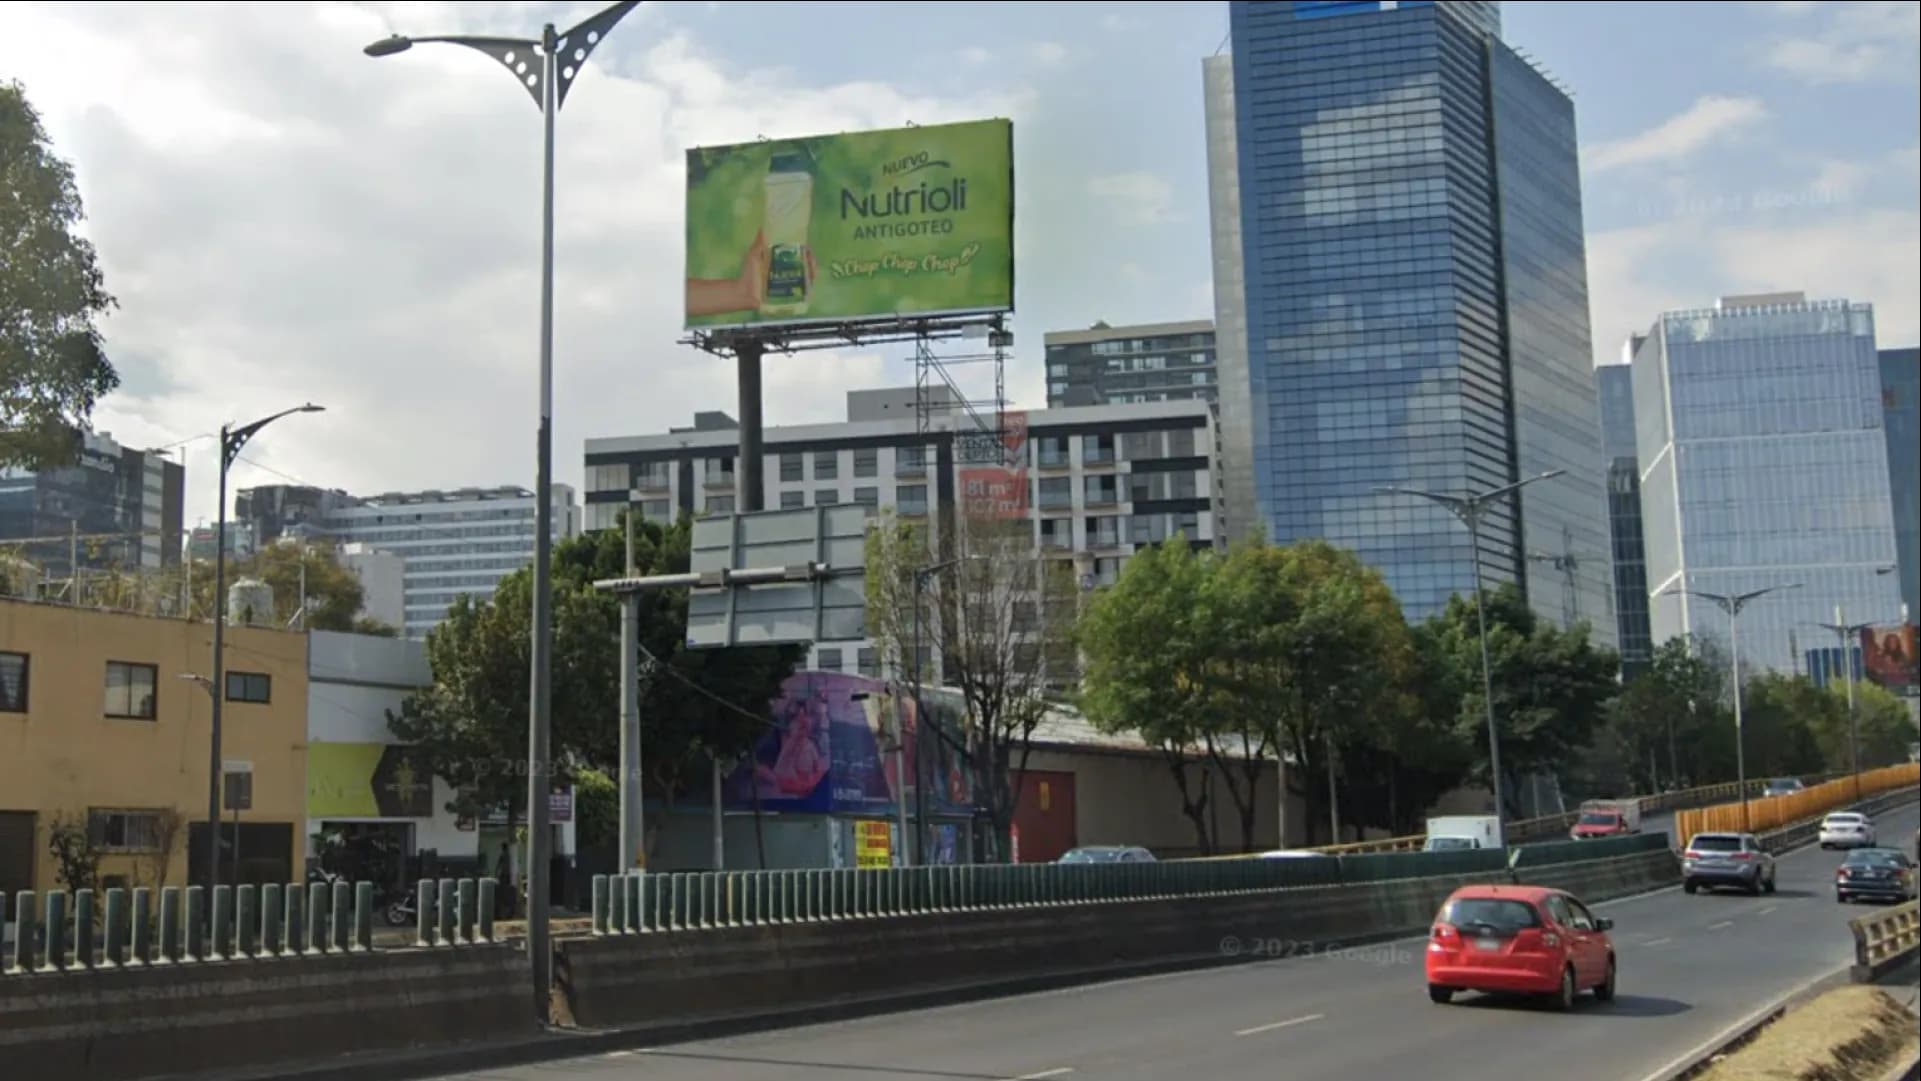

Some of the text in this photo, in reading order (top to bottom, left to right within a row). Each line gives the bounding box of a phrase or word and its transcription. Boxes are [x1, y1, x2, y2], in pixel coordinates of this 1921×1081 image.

[882, 151, 929, 176] NUEVO
[841, 178, 967, 220] Nutrioli
[853, 219, 954, 241] ANTIGOTEO
